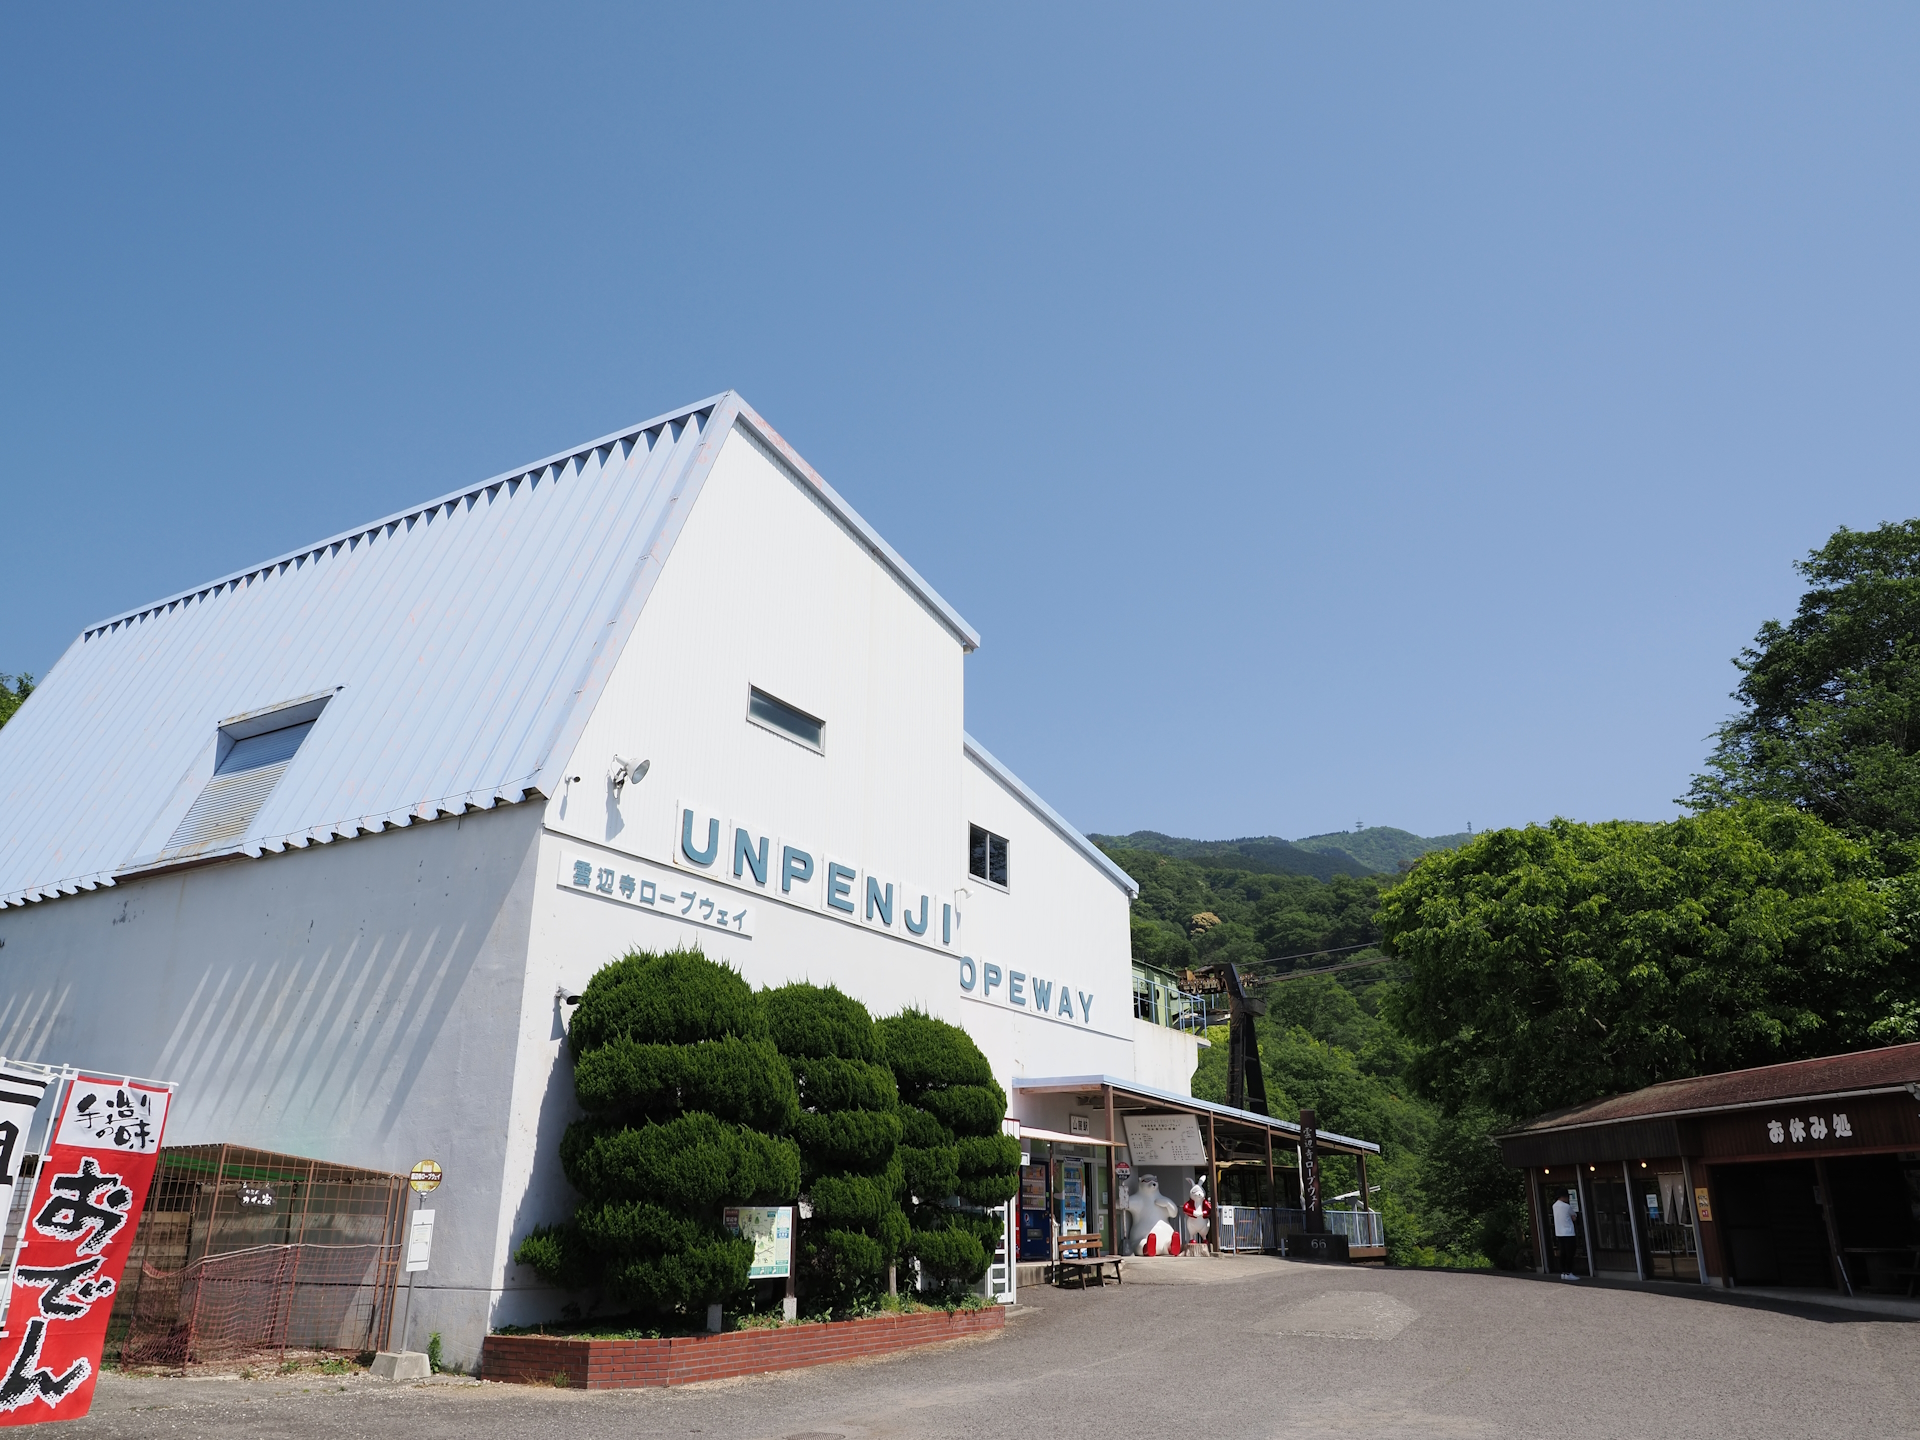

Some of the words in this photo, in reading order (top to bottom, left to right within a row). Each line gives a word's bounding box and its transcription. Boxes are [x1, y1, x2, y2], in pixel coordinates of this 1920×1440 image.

[572, 858, 749, 931] 雲辺寺ロープウェイ
[681, 808, 951, 943] UNPENJI
[1767, 1113, 1853, 1144] お休み処
[1302, 1127, 1317, 1212] 雲辺寺ロープウェイ
[1311, 1238, 1327, 1249] 66
[0, 1157, 133, 1413] おでん
